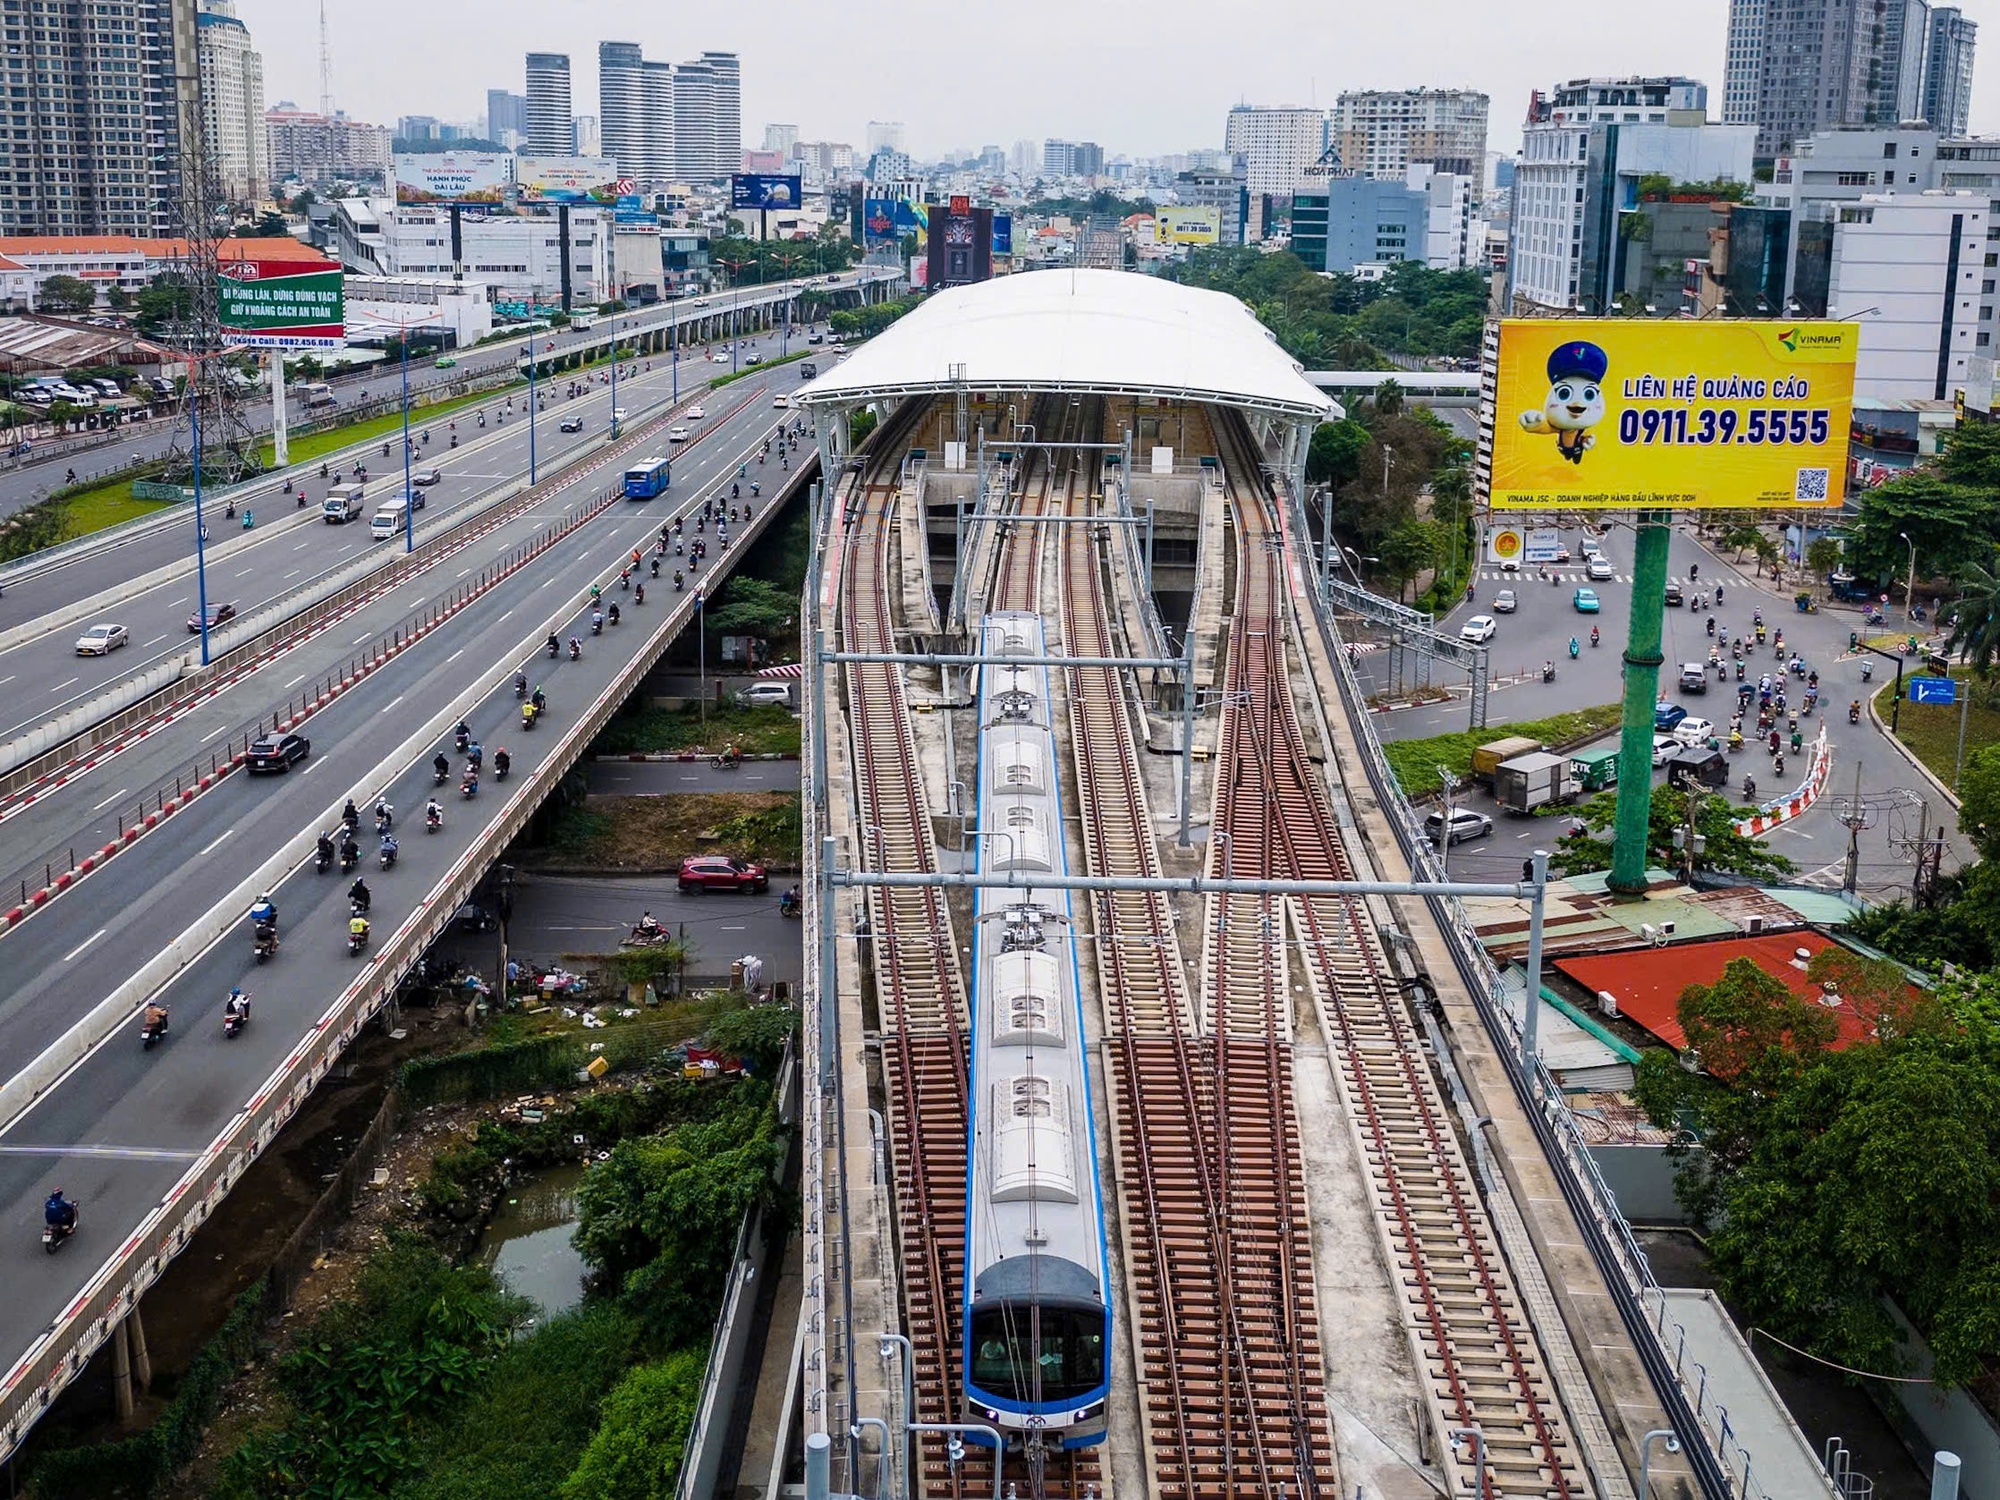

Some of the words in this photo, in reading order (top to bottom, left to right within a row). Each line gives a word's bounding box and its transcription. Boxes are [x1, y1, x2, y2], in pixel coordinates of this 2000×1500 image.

[451, 174, 472, 183] PHÚC
[564, 179, 577, 187] 49
[449, 183, 466, 191] LÂU
[867, 214, 892, 234] Tiger
[317, 291, 338, 304] VẠCH
[276, 303, 298, 317] CÁCH
[298, 307, 310, 317] AN
[311, 304, 331, 318] TOÀN
[1800, 335, 1842, 344] VINAMA
[1624, 374, 1666, 398] LIÊN
[1672, 374, 1697, 403] HỆ
[1703, 374, 1766, 398] QUẢNG
[1773, 375, 1809, 398] CÁO
[1620, 409, 1829, 444] 0911.39.5555
[1556, 494, 1581, 502] DOANH
[1583, 492, 1609, 504] NGHIỆP
[1610, 492, 1631, 502] HÀNG
[1648, 492, 1665, 502] LĨNH
[1666, 493, 1680, 503] VỰC
